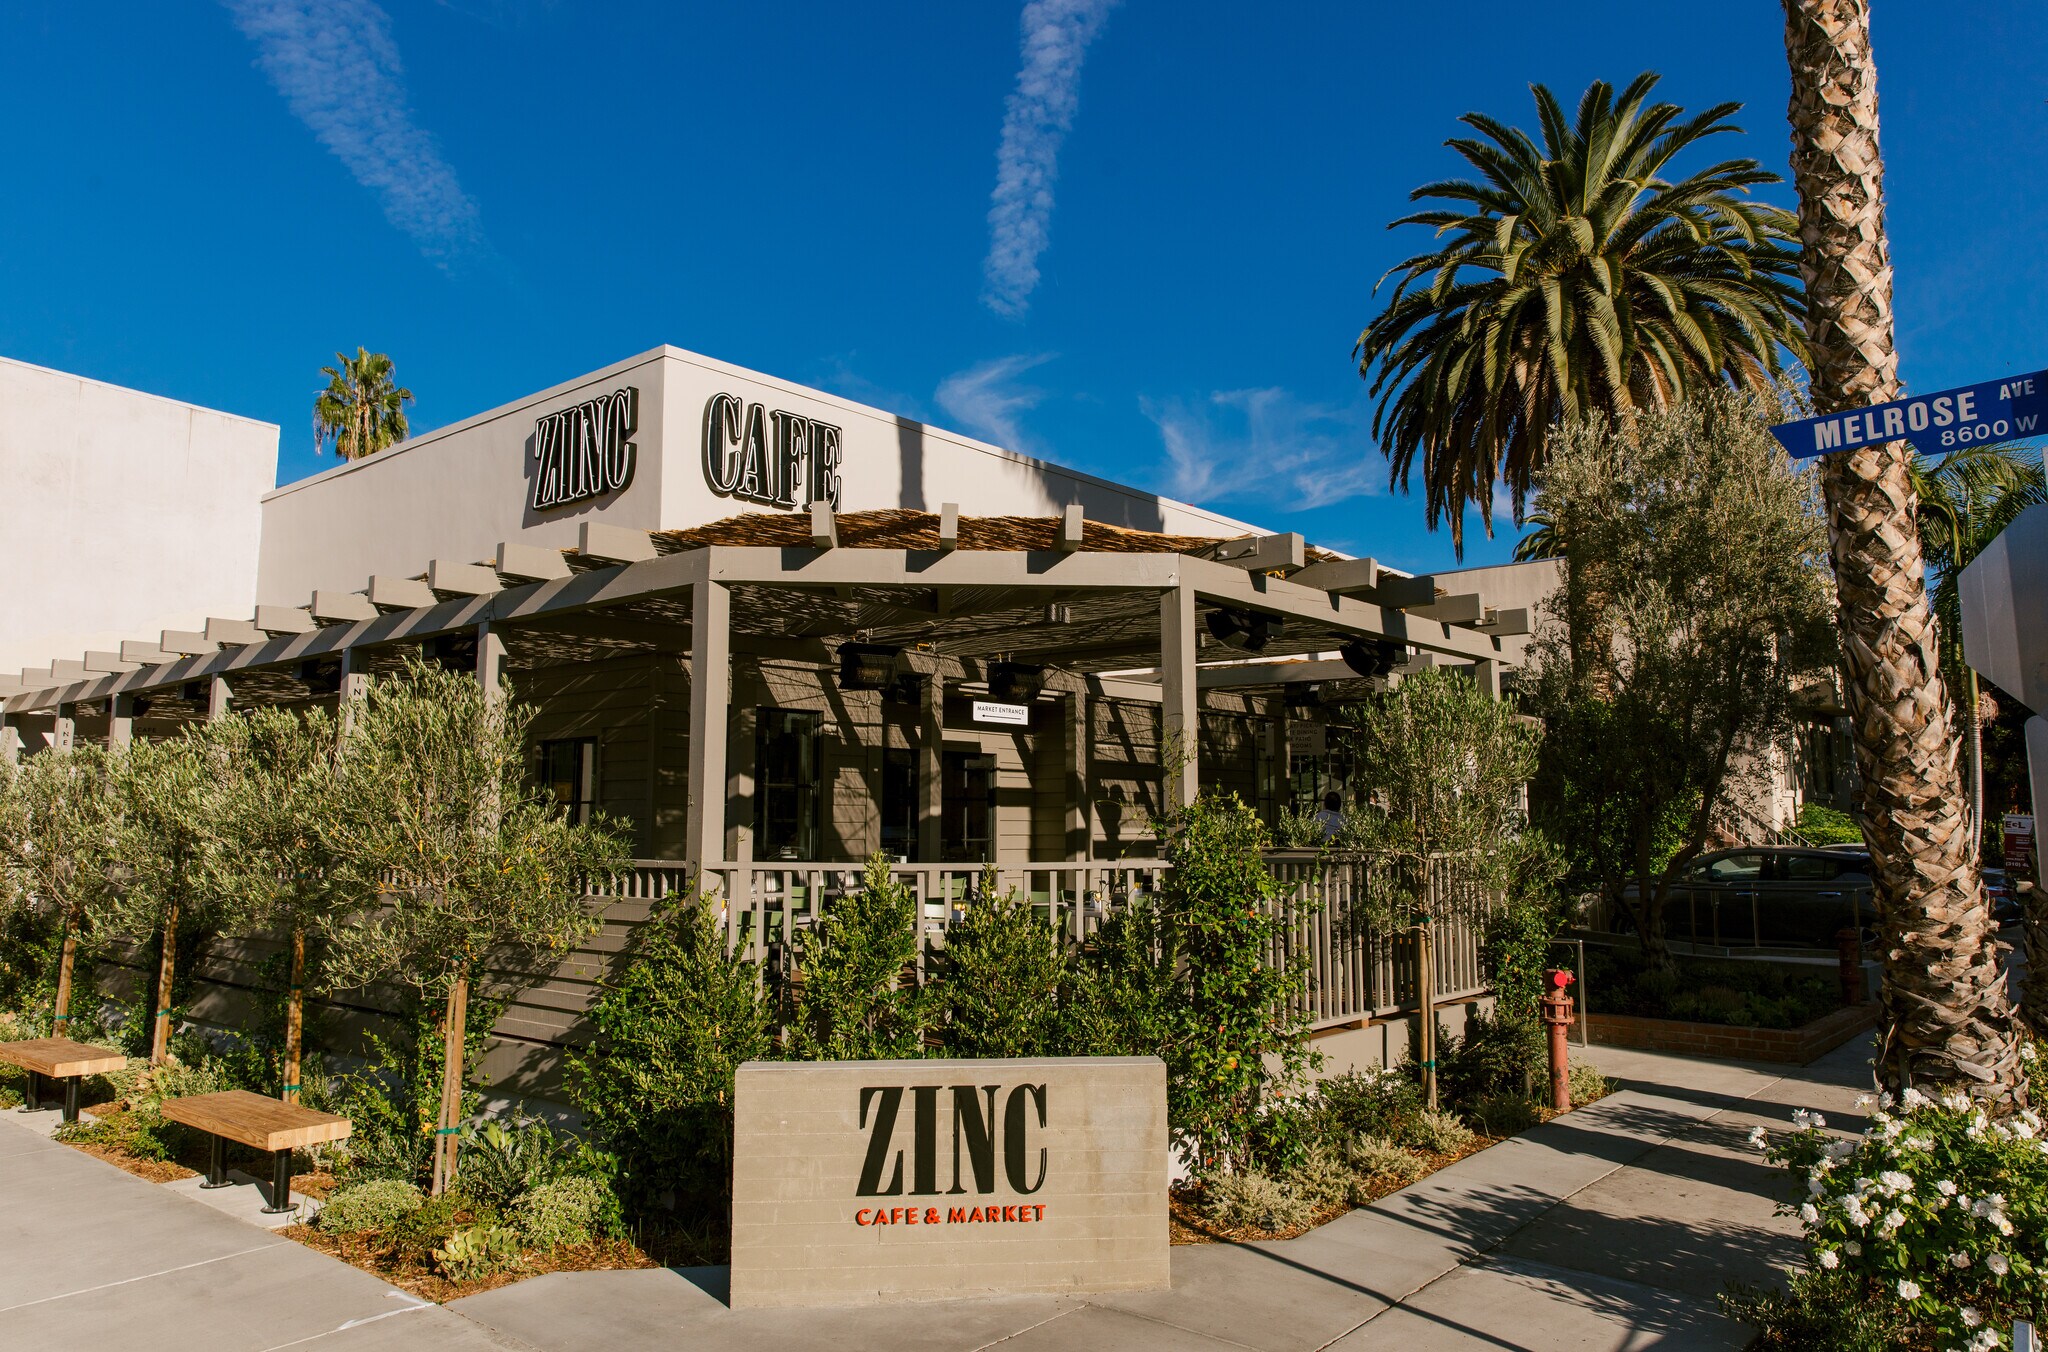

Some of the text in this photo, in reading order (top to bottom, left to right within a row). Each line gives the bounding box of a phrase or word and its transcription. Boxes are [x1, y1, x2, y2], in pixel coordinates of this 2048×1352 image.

[533, 386, 639, 512] ZINC
[1814, 379, 2035, 450] MELROSE AVE
[1941, 414, 2039, 447] 8600 W
[701, 392, 842, 513] CAFE
[999, 707, 1025, 716] ENTRANCE
[855, 1083, 1047, 1196] ZINC
[855, 1204, 1047, 1226] CAFE & MARKET
